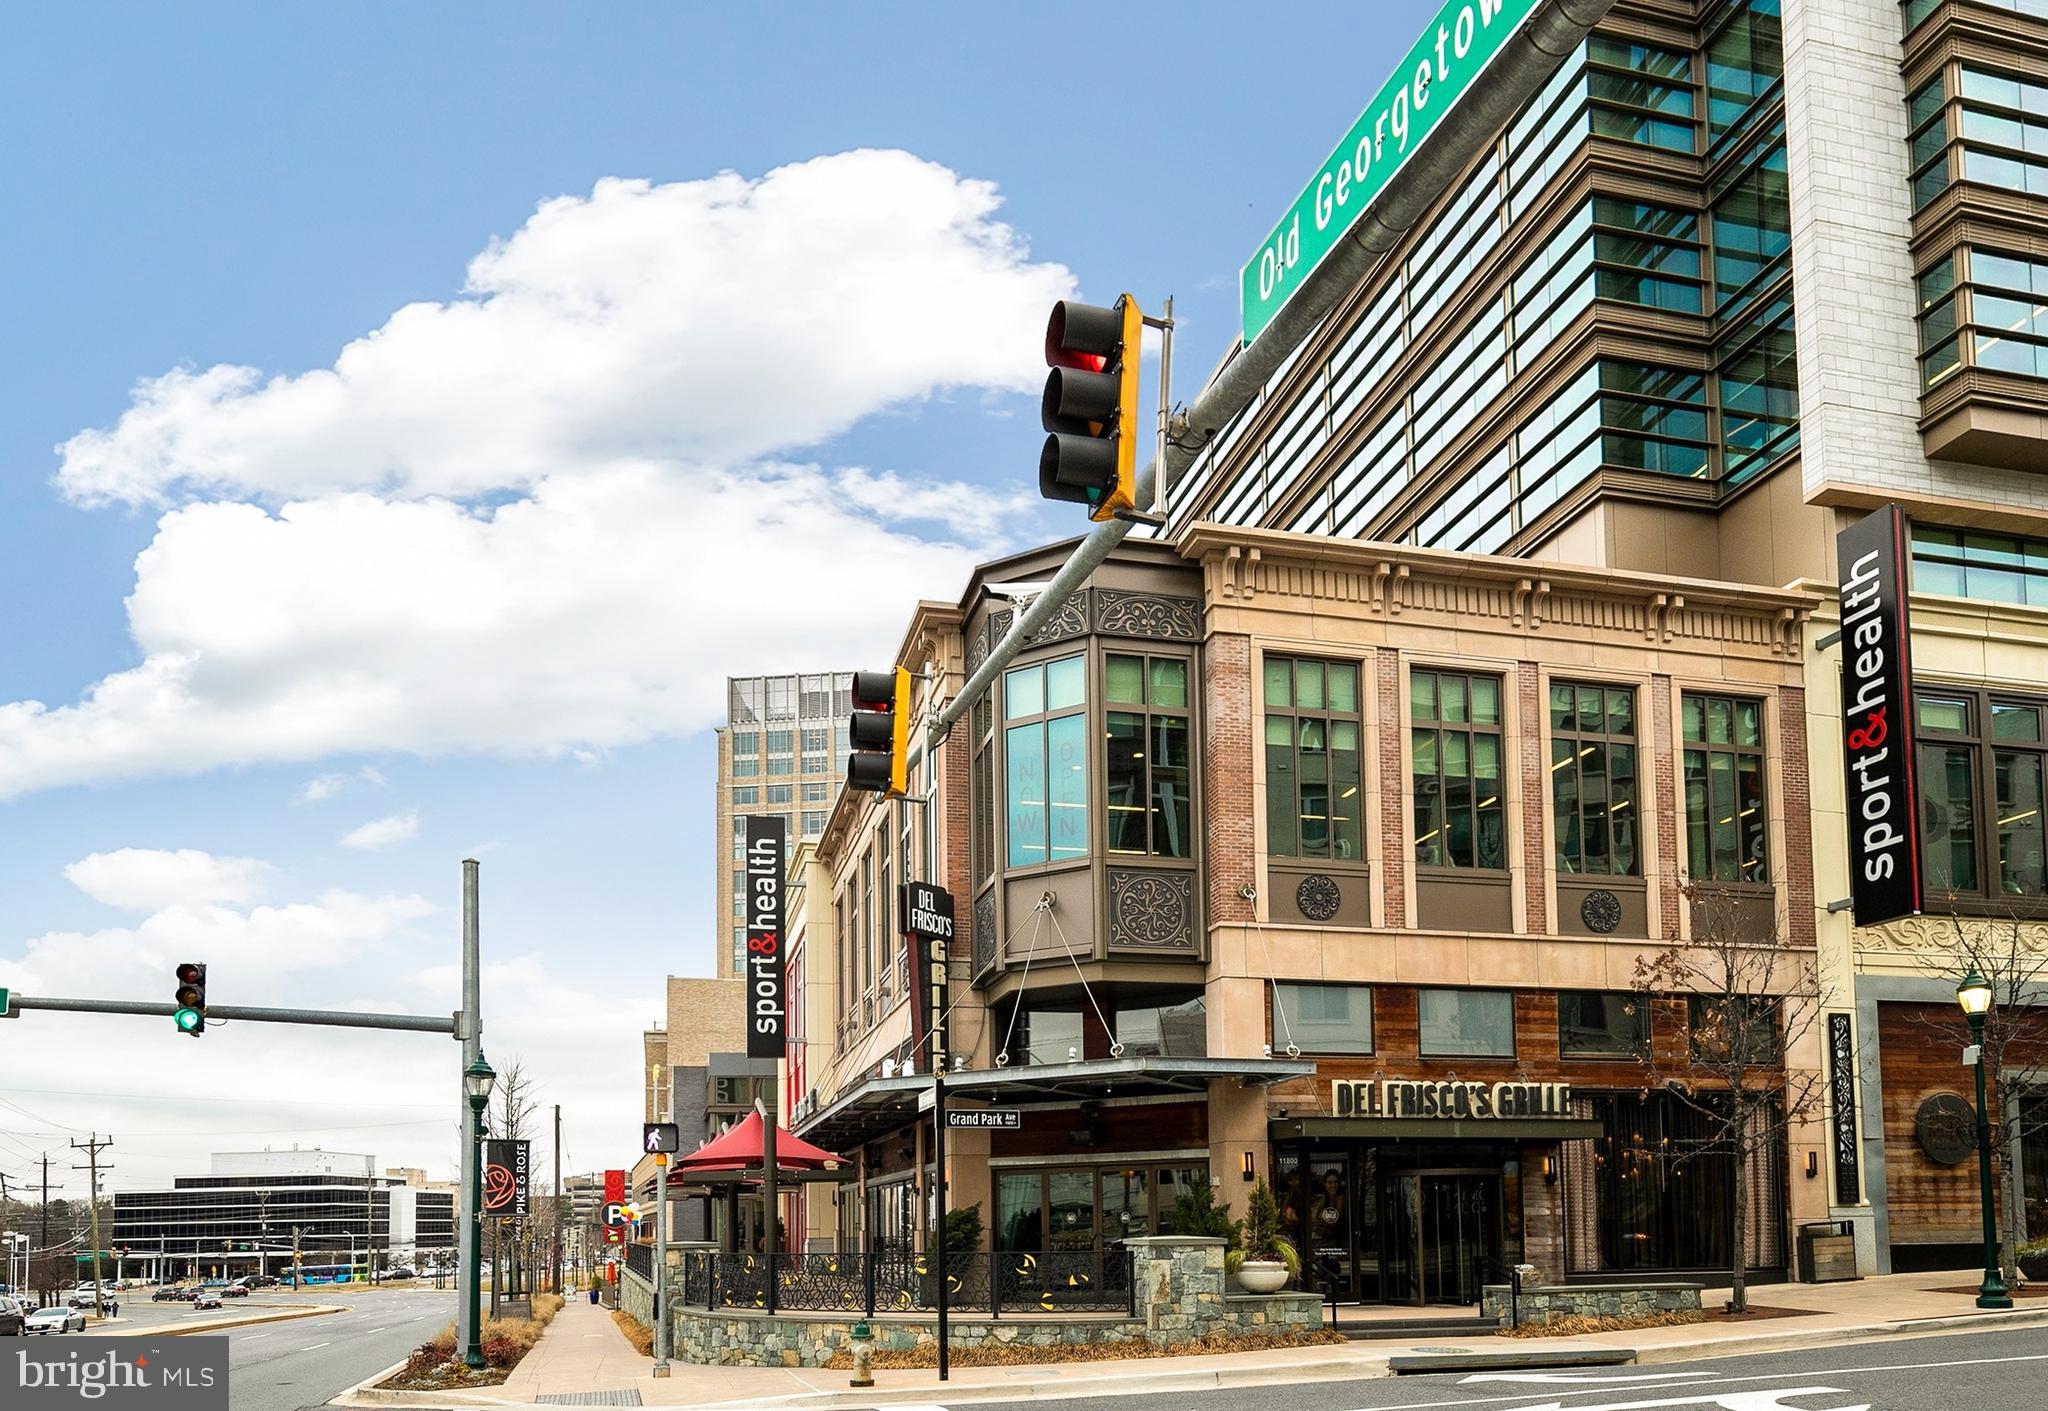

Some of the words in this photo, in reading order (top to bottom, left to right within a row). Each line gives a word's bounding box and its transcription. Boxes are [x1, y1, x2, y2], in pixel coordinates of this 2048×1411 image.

[1259, 211, 1299, 301] Old
[1841, 549, 1903, 880] sport&health
[918, 888, 936, 912] DEL
[748, 838, 784, 1034] sport&health
[911, 907, 952, 937] FRISCO'S
[930, 939, 947, 1072] GRILLE
[1332, 1079, 1381, 1118] DEL
[1382, 1080, 1490, 1119] FRISCO'S
[1491, 1081, 1571, 1119] GRILLE
[949, 1113, 979, 1125] Grand
[981, 1113, 1003, 1125] Park
[1004, 1113, 1016, 1121] Ave
[516, 1143, 527, 1173] ROSE
[1279, 1157, 1298, 1165] 11800
[516, 1176, 527, 1185] &
[516, 1187, 526, 1214] PIKE
[608, 1204, 622, 1225] P
